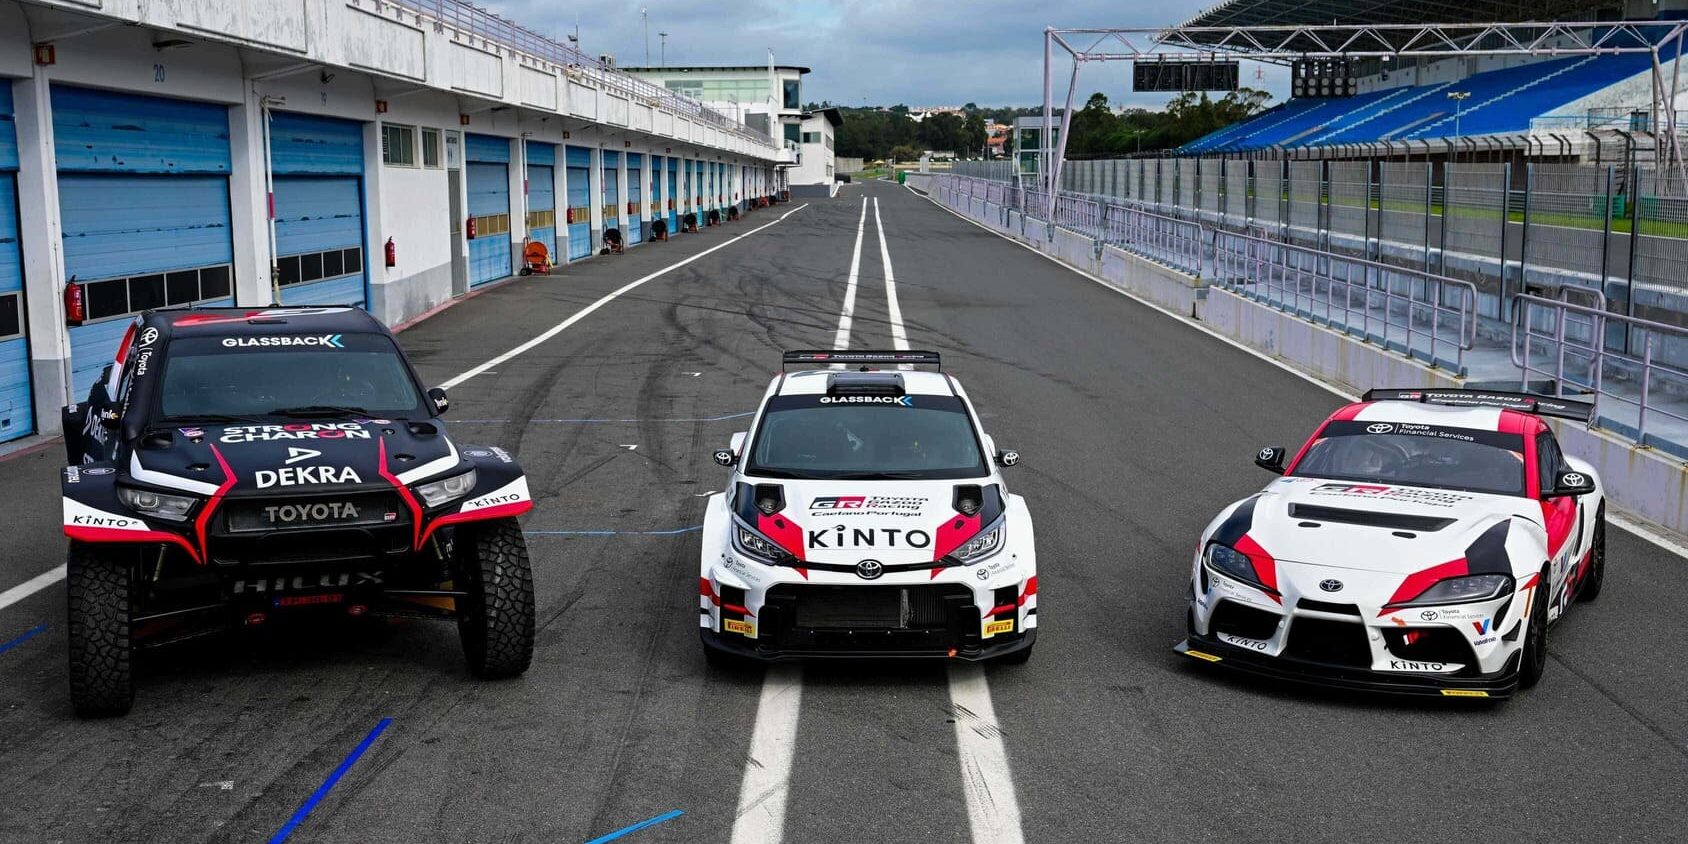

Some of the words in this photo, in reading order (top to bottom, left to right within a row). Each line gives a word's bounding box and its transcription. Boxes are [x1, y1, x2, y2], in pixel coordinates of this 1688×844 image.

[153, 64, 165, 82] 20
[222, 334, 336, 347] GLASSBACK
[137, 351, 153, 376] Toyota
[820, 396, 907, 407] GLASSBACK
[223, 423, 362, 434] STRONG
[1400, 423, 1430, 431] Toyota
[219, 430, 371, 444] CHARON
[1399, 428, 1437, 437] Financial
[1439, 431, 1474, 442] Services
[255, 466, 362, 489] DEKRA
[811, 497, 865, 509] GR
[265, 503, 359, 522] TOYOTA
[233, 571, 384, 594] HILUX
[986, 622, 1012, 634] PIRELLI
